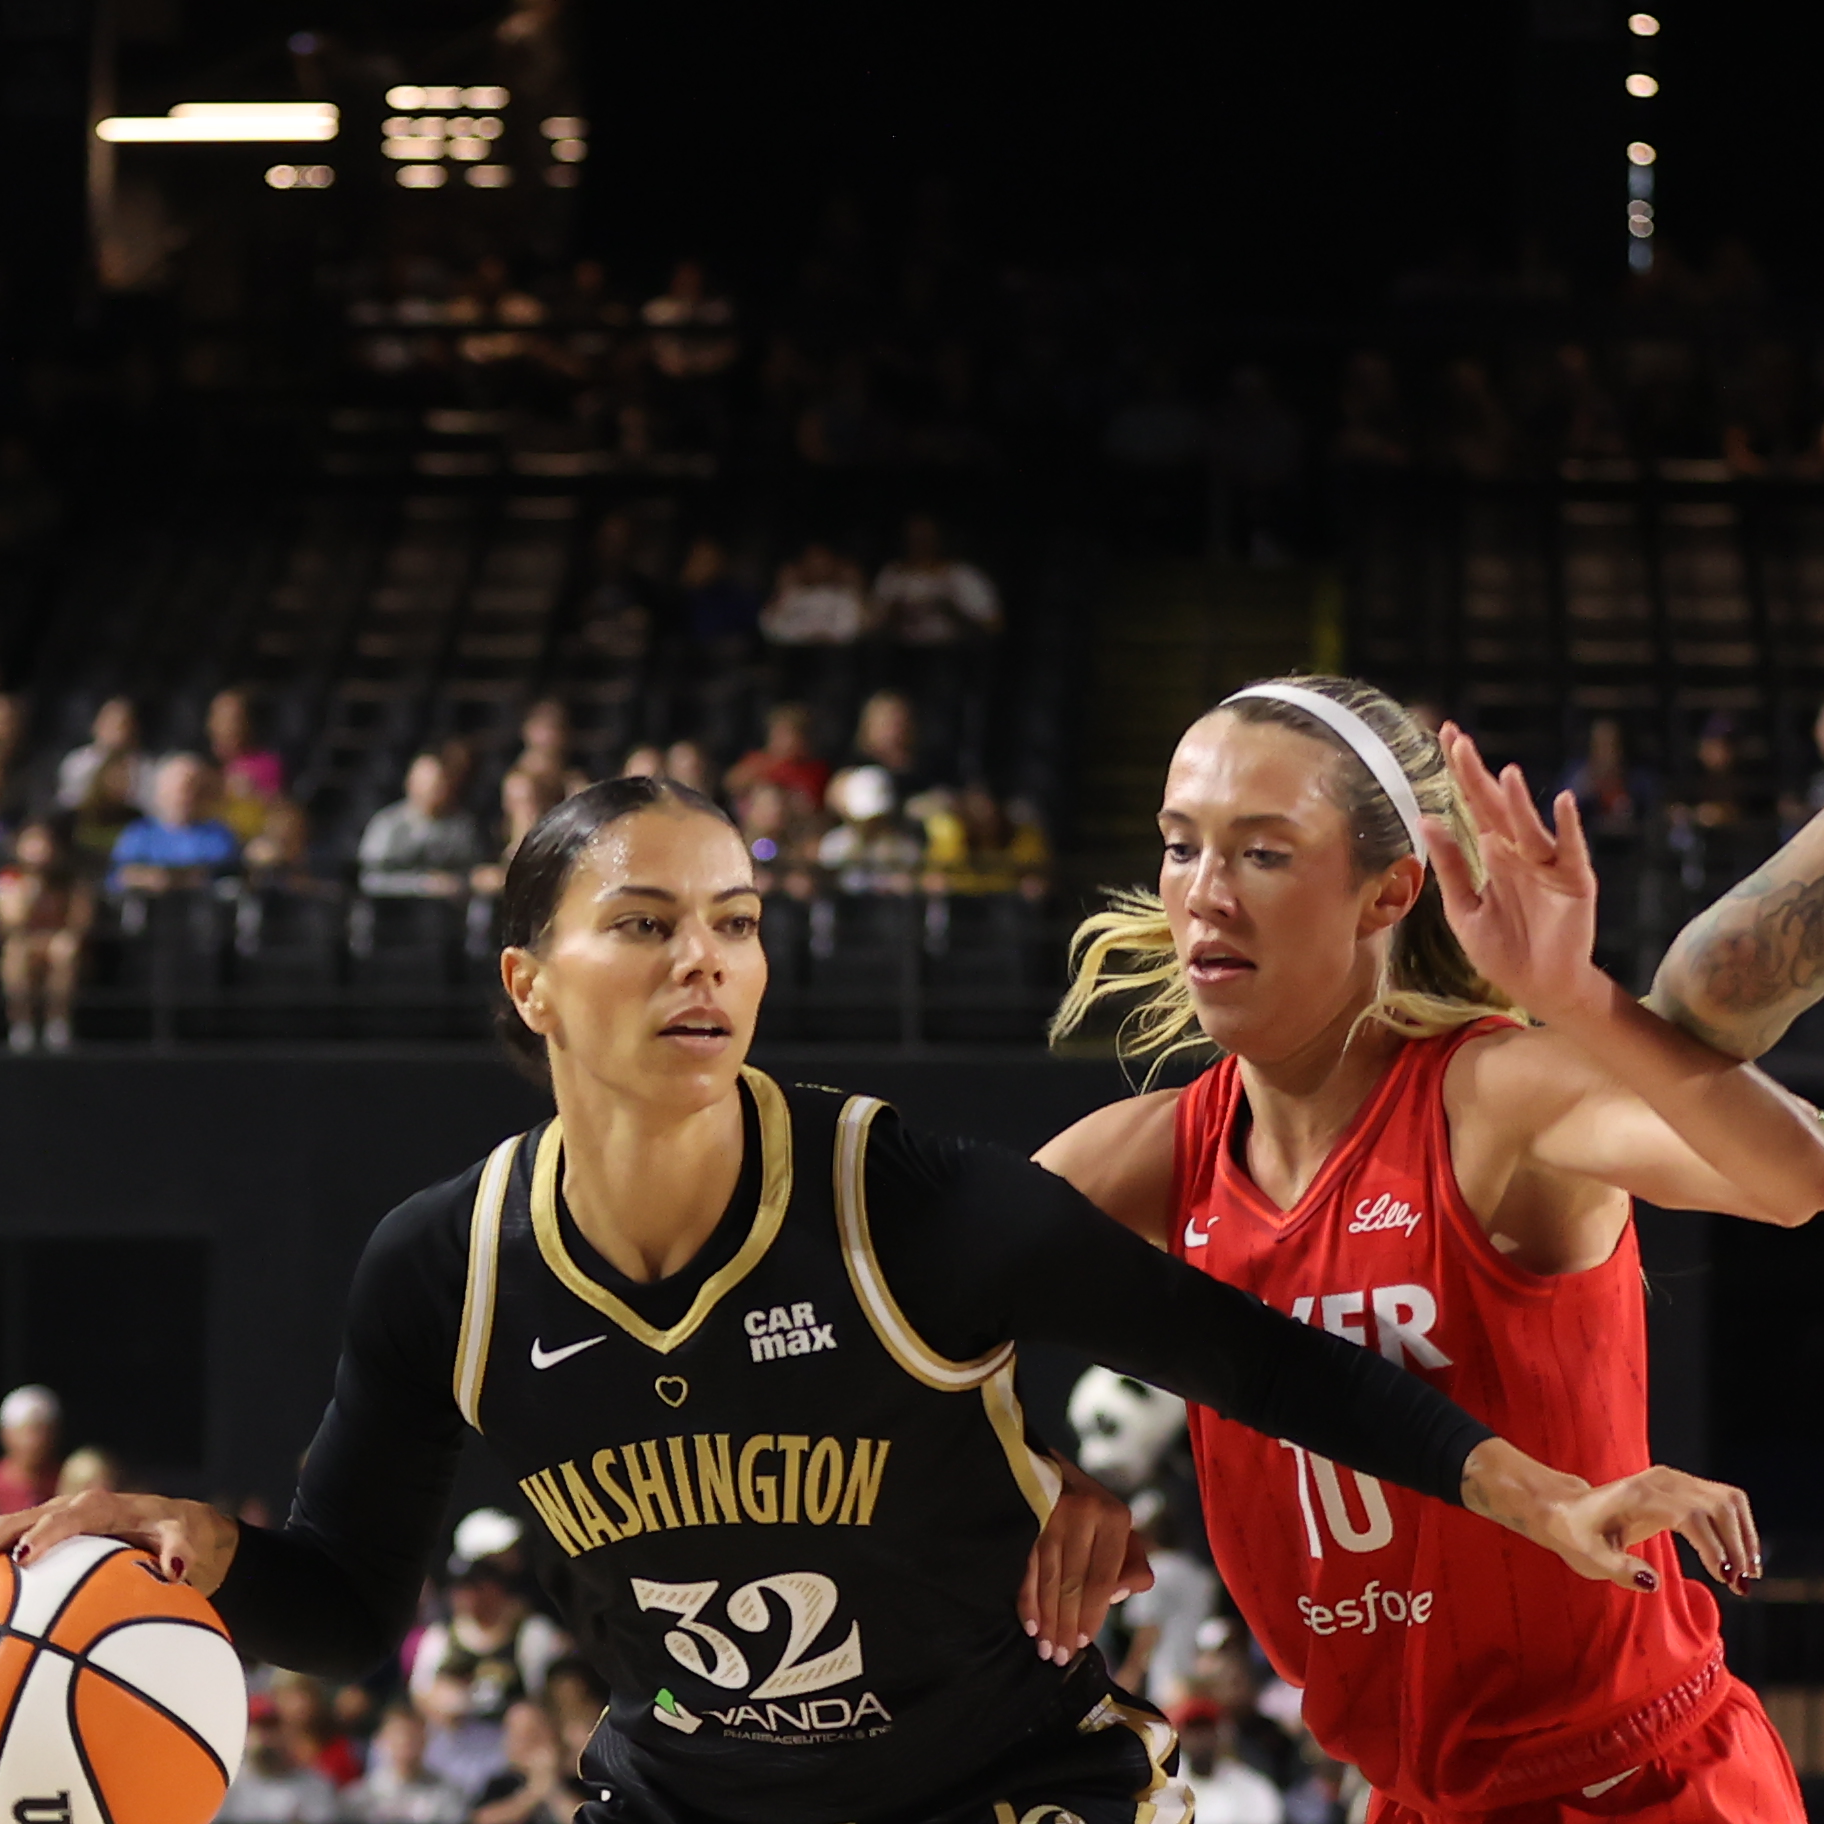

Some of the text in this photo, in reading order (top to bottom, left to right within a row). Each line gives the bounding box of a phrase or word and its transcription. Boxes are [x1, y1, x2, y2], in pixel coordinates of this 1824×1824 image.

[1348, 1194, 1423, 1238] Lilly
[743, 1302, 816, 1337] CAR
[749, 1322, 838, 1363] max
[518, 1433, 891, 1558] WASHINGTON
[1280, 1439, 1393, 1559] 10
[630, 1571, 864, 1700] 32
[701, 1691, 893, 1732] VANDA
